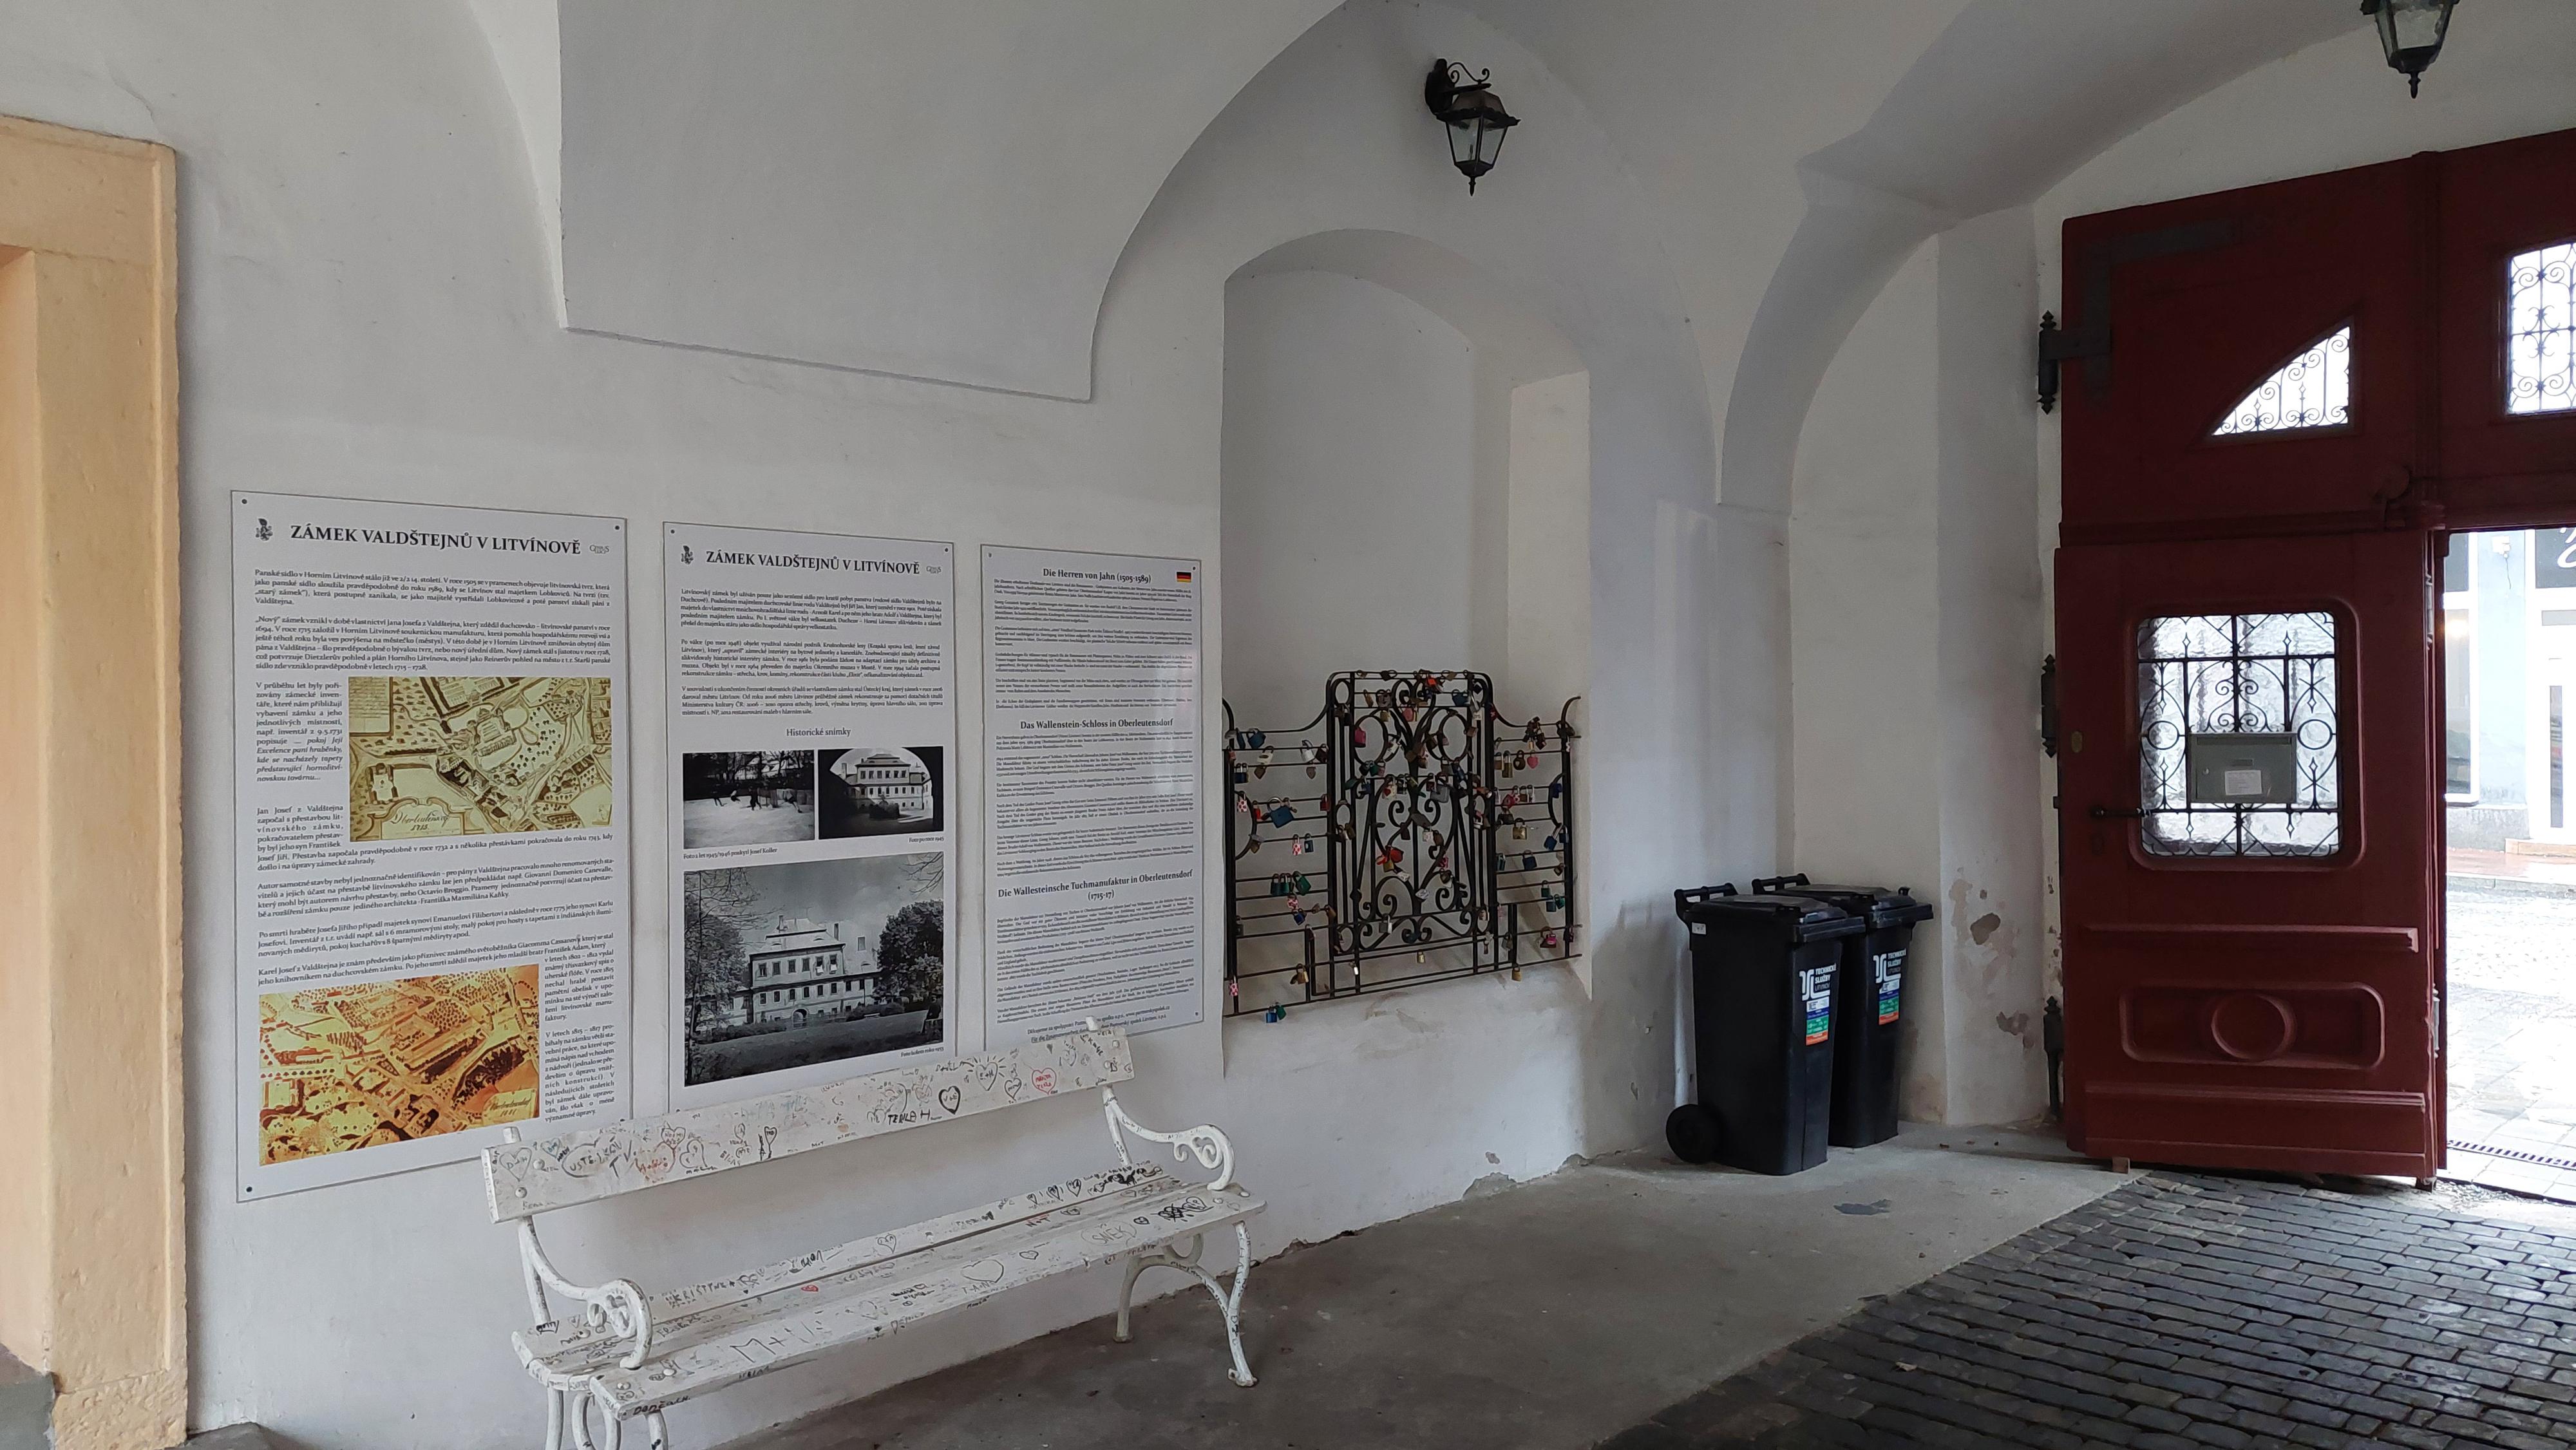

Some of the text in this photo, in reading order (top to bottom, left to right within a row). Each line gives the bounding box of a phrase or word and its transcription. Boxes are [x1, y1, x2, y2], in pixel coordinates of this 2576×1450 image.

[291, 523, 358, 541] ZÁMEK
[361, 529, 473, 550] VALDŠTEJNŮ
[476, 537, 488, 549] V
[492, 537, 581, 554] LITVÍNOVĚ
[706, 551, 755, 565] ZÁMEK
[758, 554, 840, 572] VALDŠTEJNŮ
[842, 560, 851, 570] V
[854, 560, 920, 574] LITVÍNOVĚ
[1043, 569, 1056, 577] Die
[1058, 569, 1083, 578] Herren
[1099, 572, 1115, 581] Jahn
[1117, 572, 1151, 584] (1505-1589)
[255, 597, 294, 605] Valdštejna.
[264, 682, 294, 690] průběhu
[308, 682, 323, 690] byly
[256, 710, 289, 718] vybavení
[256, 719, 301, 728] jednotlivých
[1036, 719, 1108, 729] Wallenstein-Schloss
[1118, 719, 1173, 727] Oberleutensdorf
[786, 728, 851, 737] Historické snímky
[283, 755, 318, 764] nacházely
[274, 806, 293, 815] Josef
[257, 816, 285, 825] započal
[292, 814, 331, 824] přestavbou
[257, 824, 307, 833] vínovského
[258, 833, 314, 844] pokračovatelem
[258, 845, 266, 853] by
[267, 844, 278, 852] byl
[279, 843, 295, 852] jeho
[308, 840, 341, 849] František
[258, 854, 276, 863] Josef
[292, 851, 326, 860] Přestavba
[328, 849, 358, 858] započala
[360, 846, 412, 857] pravděpodobně
[489, 839, 526, 849] přestávkami
[527, 836, 563, 846] pokračovala
[316, 859, 347, 867] zámecké
[347, 857, 375, 865] zahrady.
[998, 889, 1012, 898] Die
[1013, 883, 1070, 896] Wallesteinsche
[1071, 877, 1130, 890] Tuchmanufaktur
[1139, 869, 1193, 883] Oberleutensdorf
[1088, 889, 1114, 901] (1715-17)
